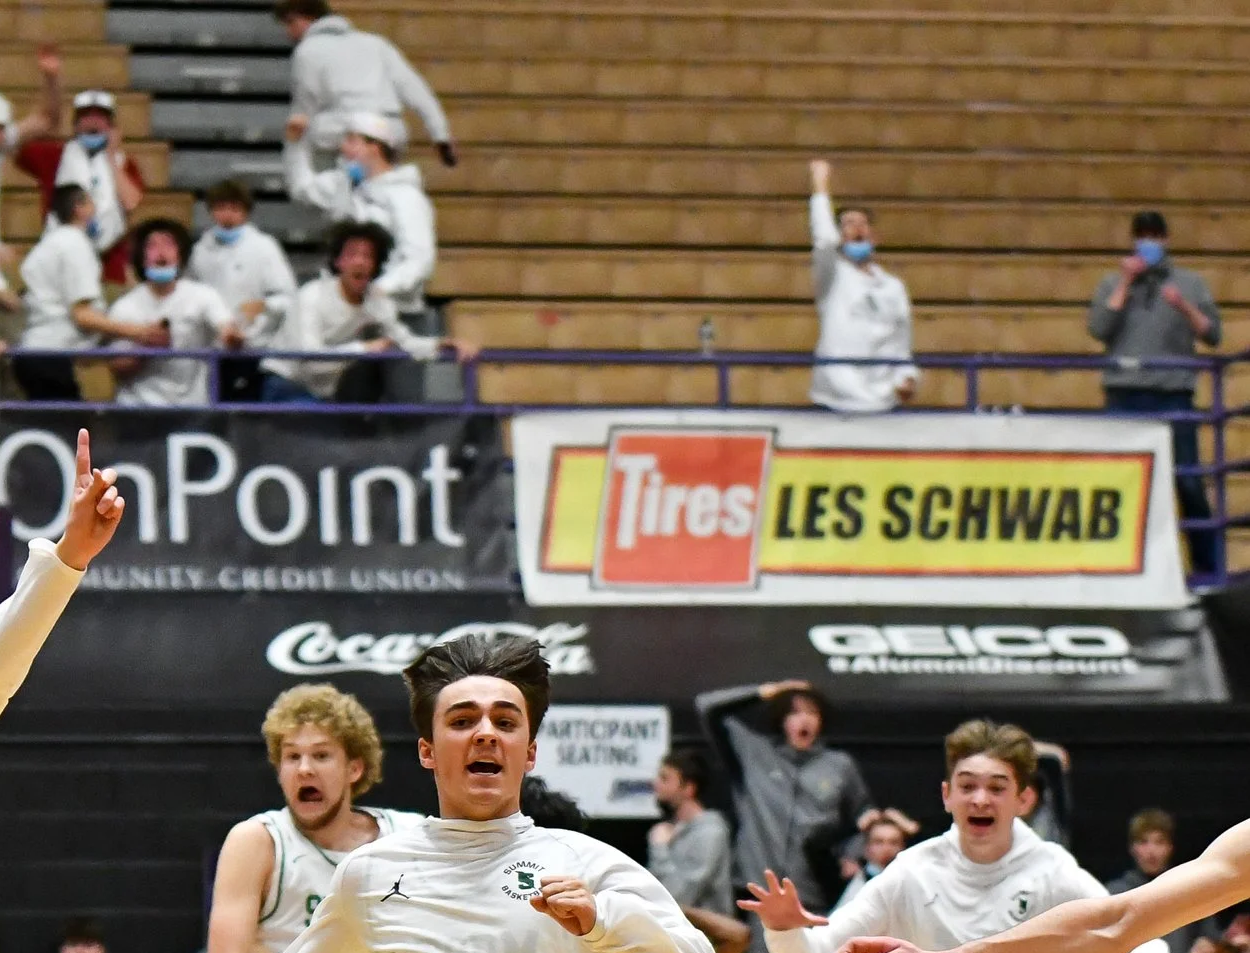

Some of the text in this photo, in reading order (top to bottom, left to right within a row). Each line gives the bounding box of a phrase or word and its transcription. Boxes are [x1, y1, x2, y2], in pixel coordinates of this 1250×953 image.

[615, 453, 1121, 551] Tires LES SCHWAB
[217, 566, 336, 591] CREDIT
[350, 566, 466, 592] UNION
[808, 623, 1132, 658] GEICO
[556, 743, 638, 766] SEATING
[503, 861, 546, 875] SUMMIT
